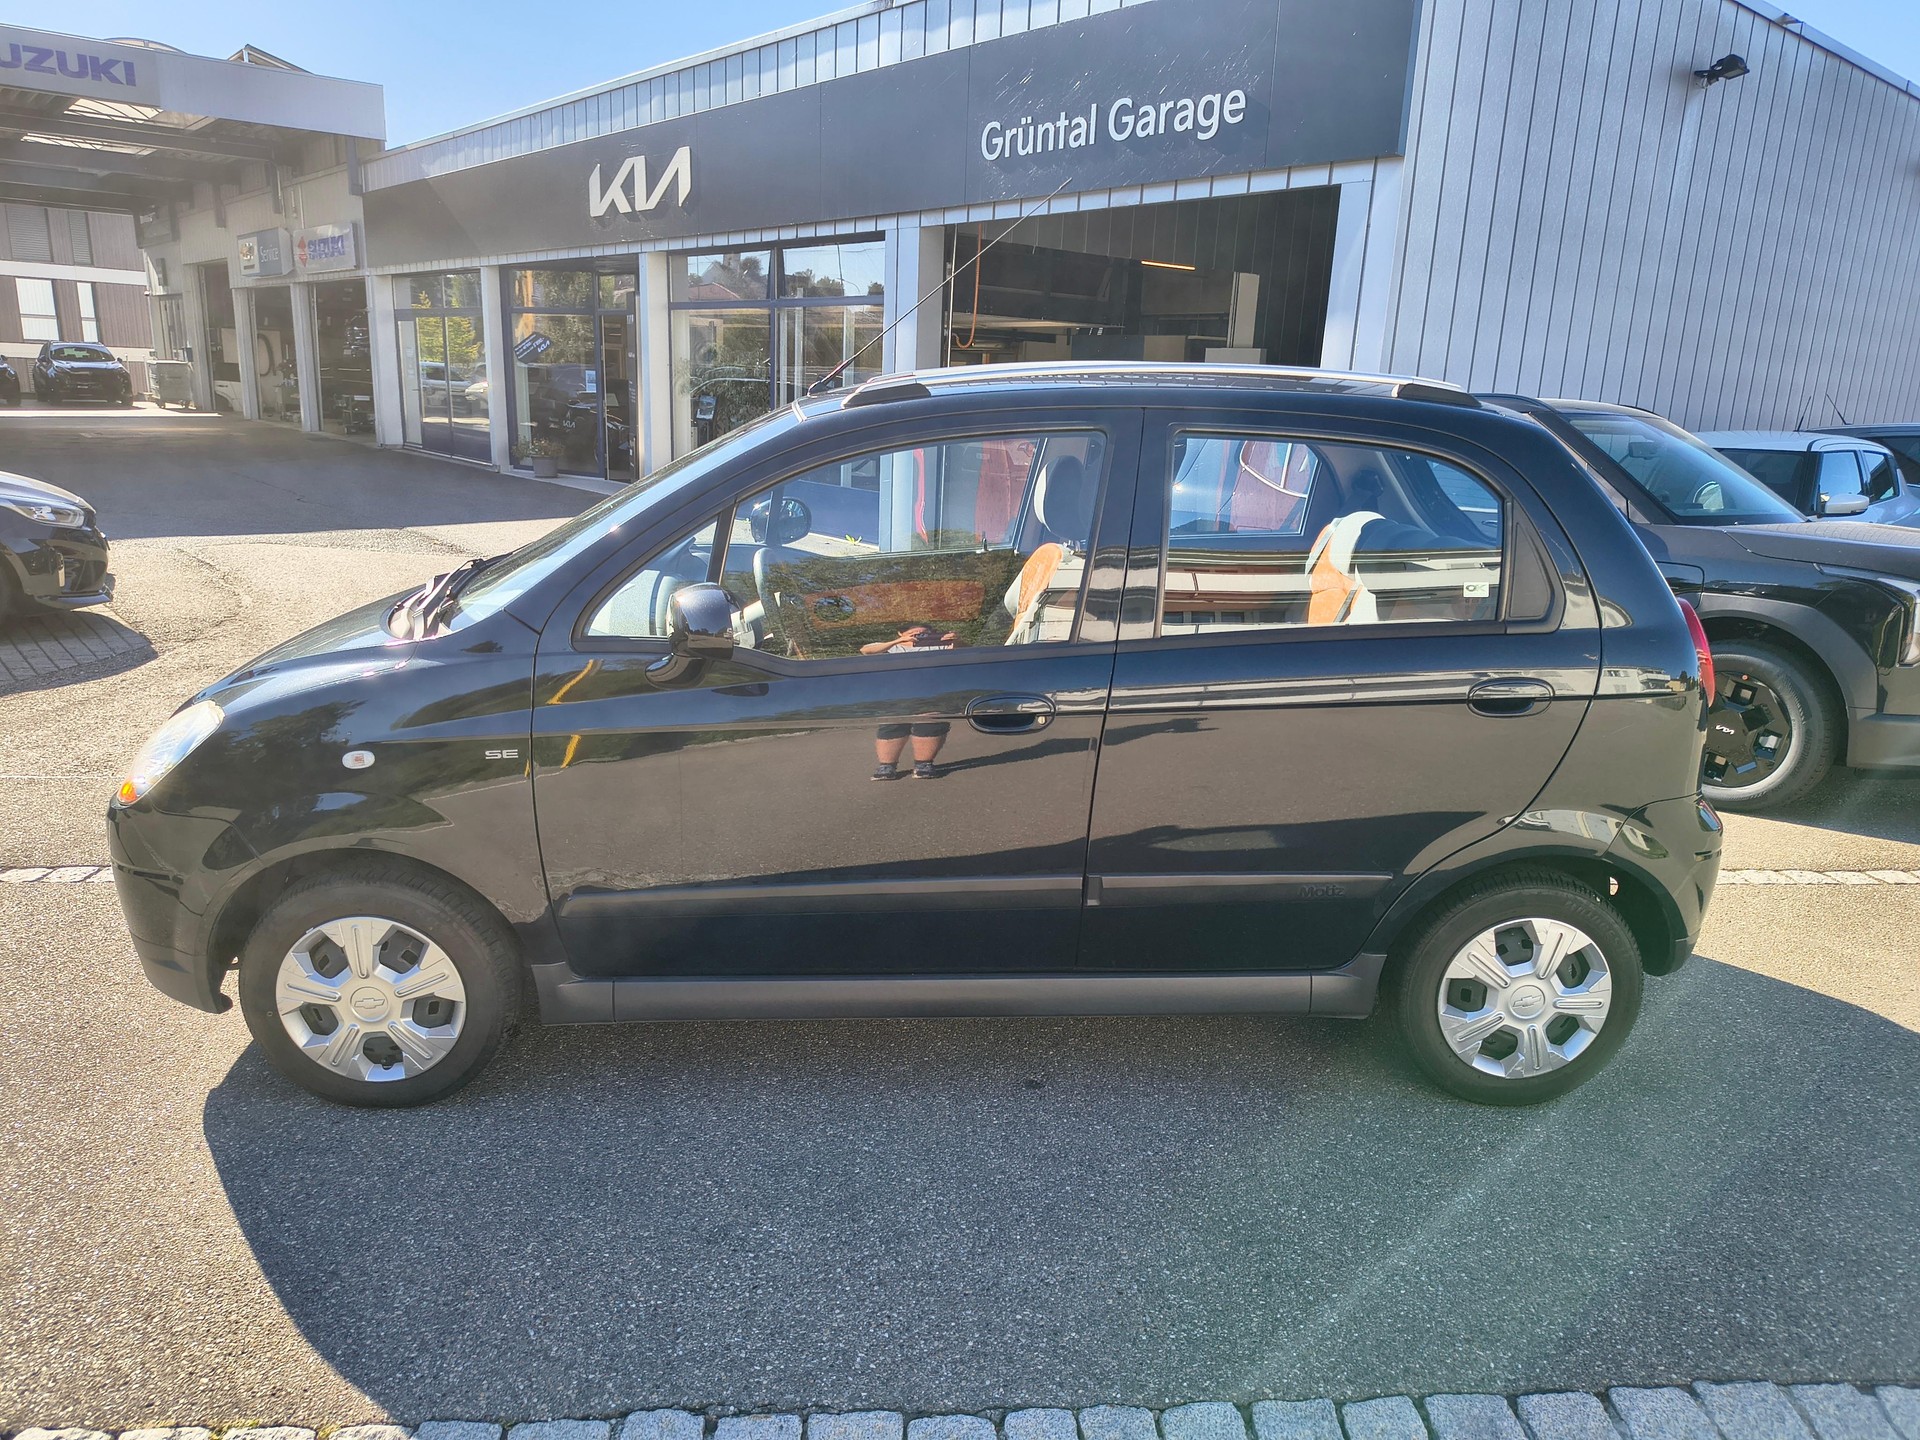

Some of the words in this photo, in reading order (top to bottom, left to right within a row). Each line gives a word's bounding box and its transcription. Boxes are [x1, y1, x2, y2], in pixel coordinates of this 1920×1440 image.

[981, 103, 1097, 161] Grüntal
[1108, 89, 1246, 141] Garage
[588, 146, 692, 217] KIA
[260, 244, 279, 263] Service
[485, 749, 519, 760] SE
